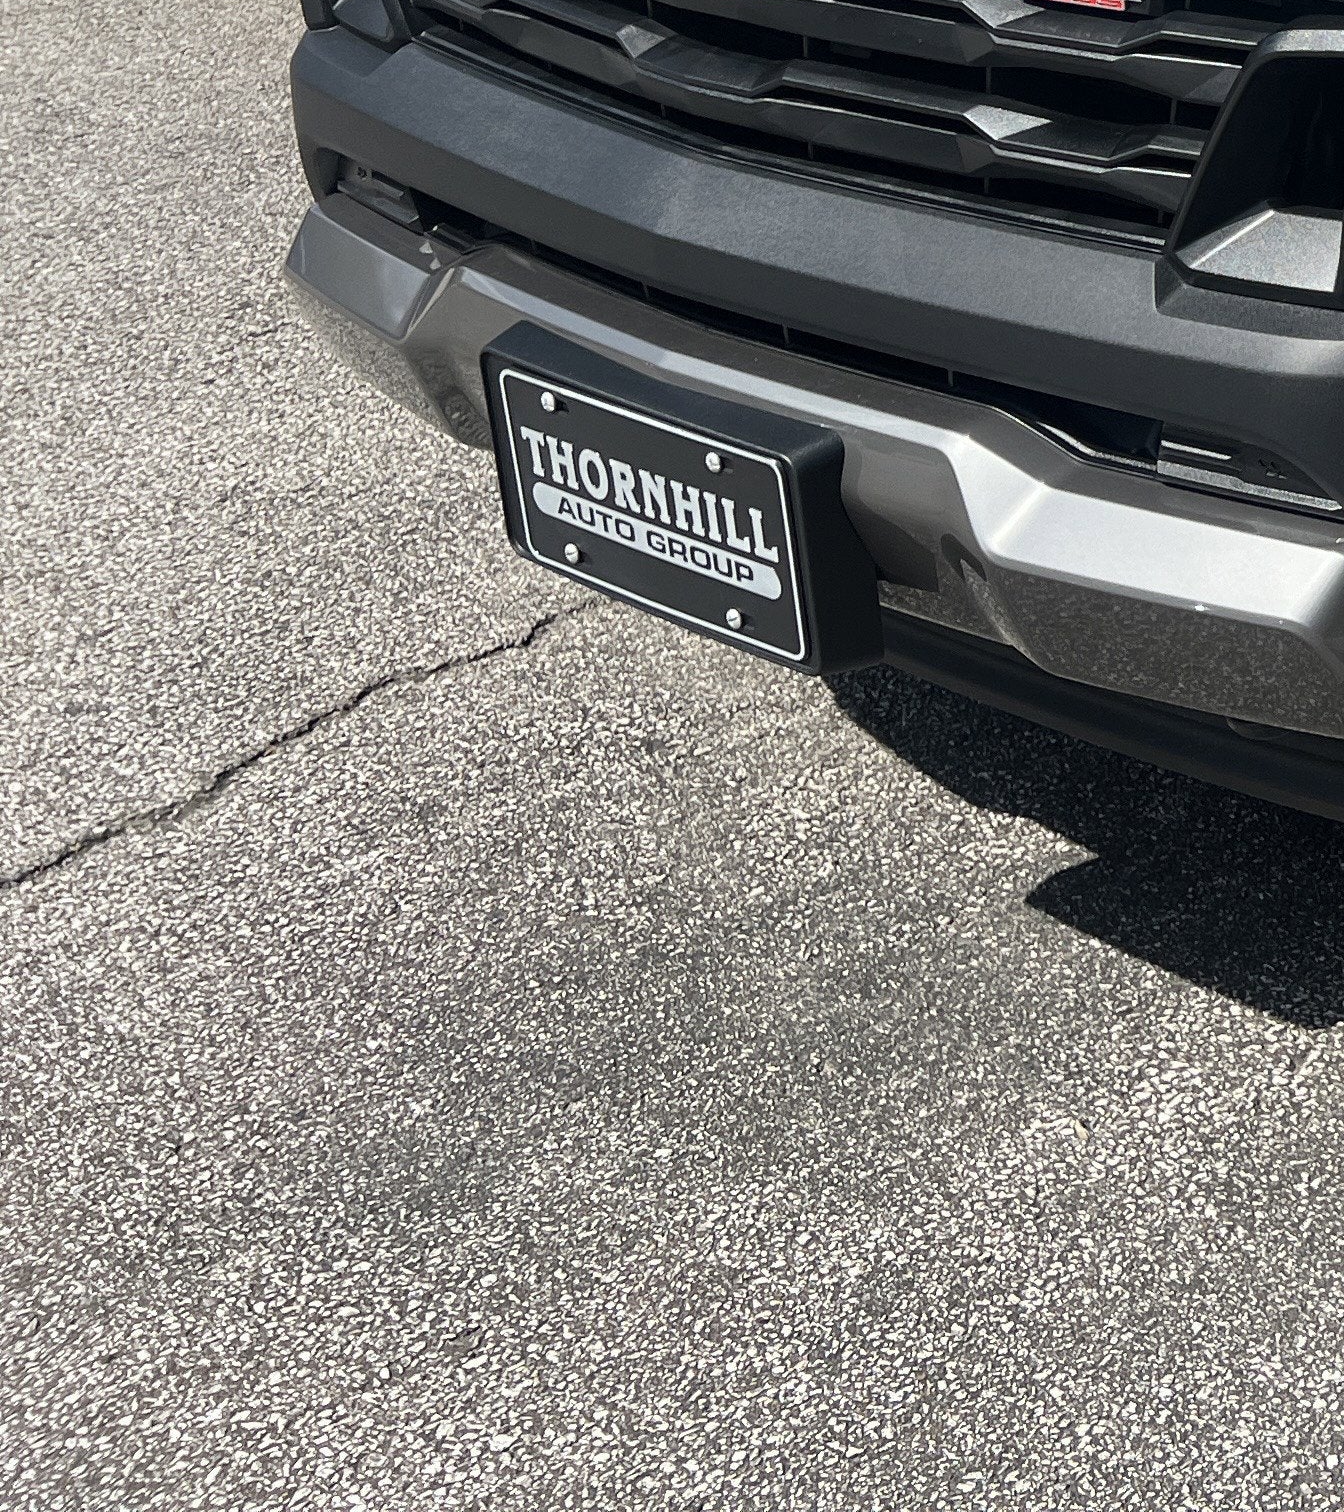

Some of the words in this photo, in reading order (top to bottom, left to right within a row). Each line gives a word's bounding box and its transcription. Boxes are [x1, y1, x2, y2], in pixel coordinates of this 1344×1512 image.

[520, 426, 779, 563] THORNHILL
[557, 497, 635, 543] AUTO
[647, 530, 754, 583] GROUP
